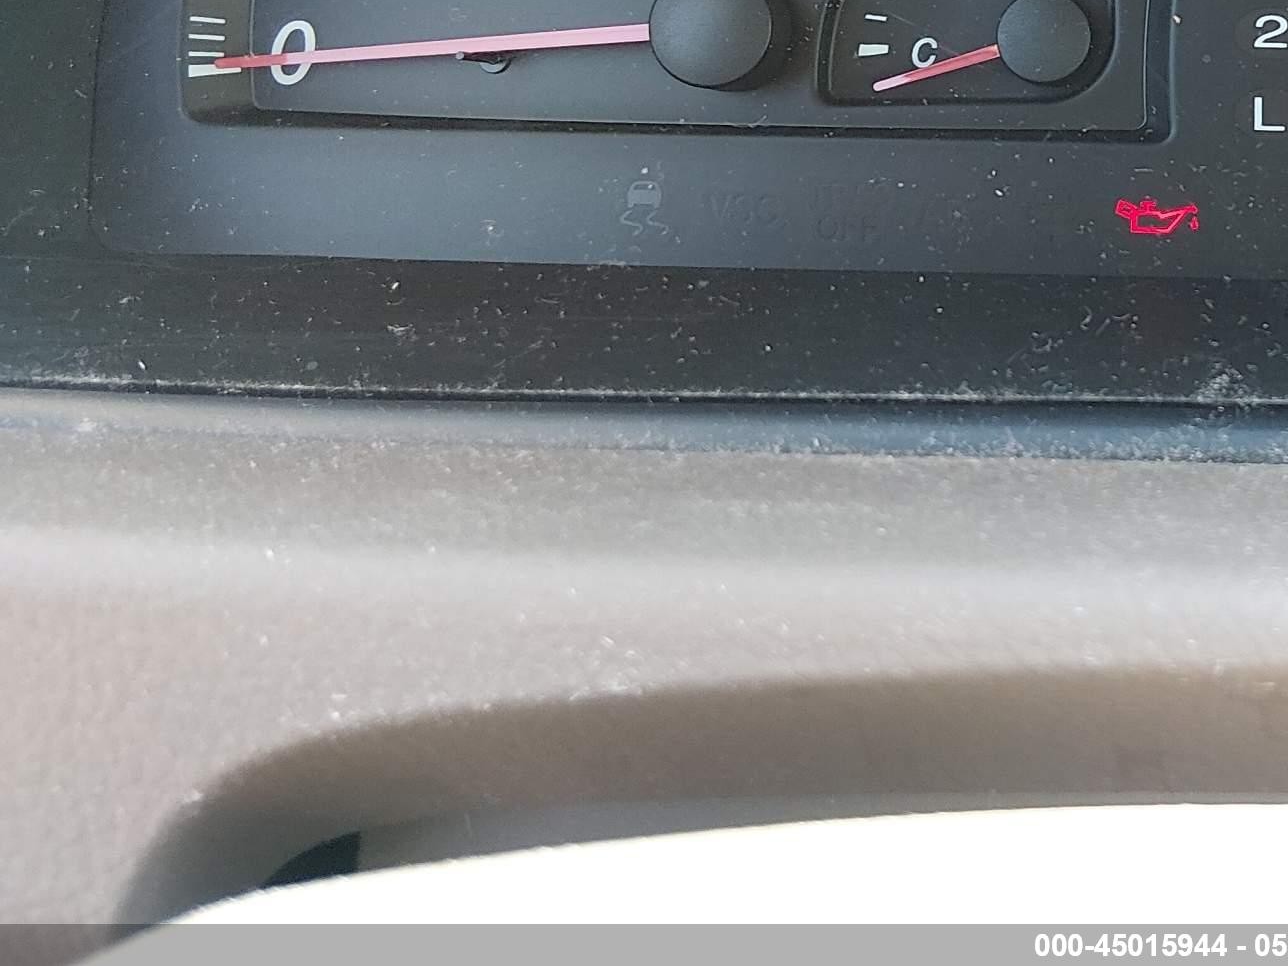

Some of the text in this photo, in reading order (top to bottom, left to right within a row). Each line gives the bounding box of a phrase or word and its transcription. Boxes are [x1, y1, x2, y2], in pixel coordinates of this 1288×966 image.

[1254, 15, 1288, 48] 2
[270, 19, 316, 85] 0
[910, 37, 937, 68] C
[1254, 97, 1285, 131] L
